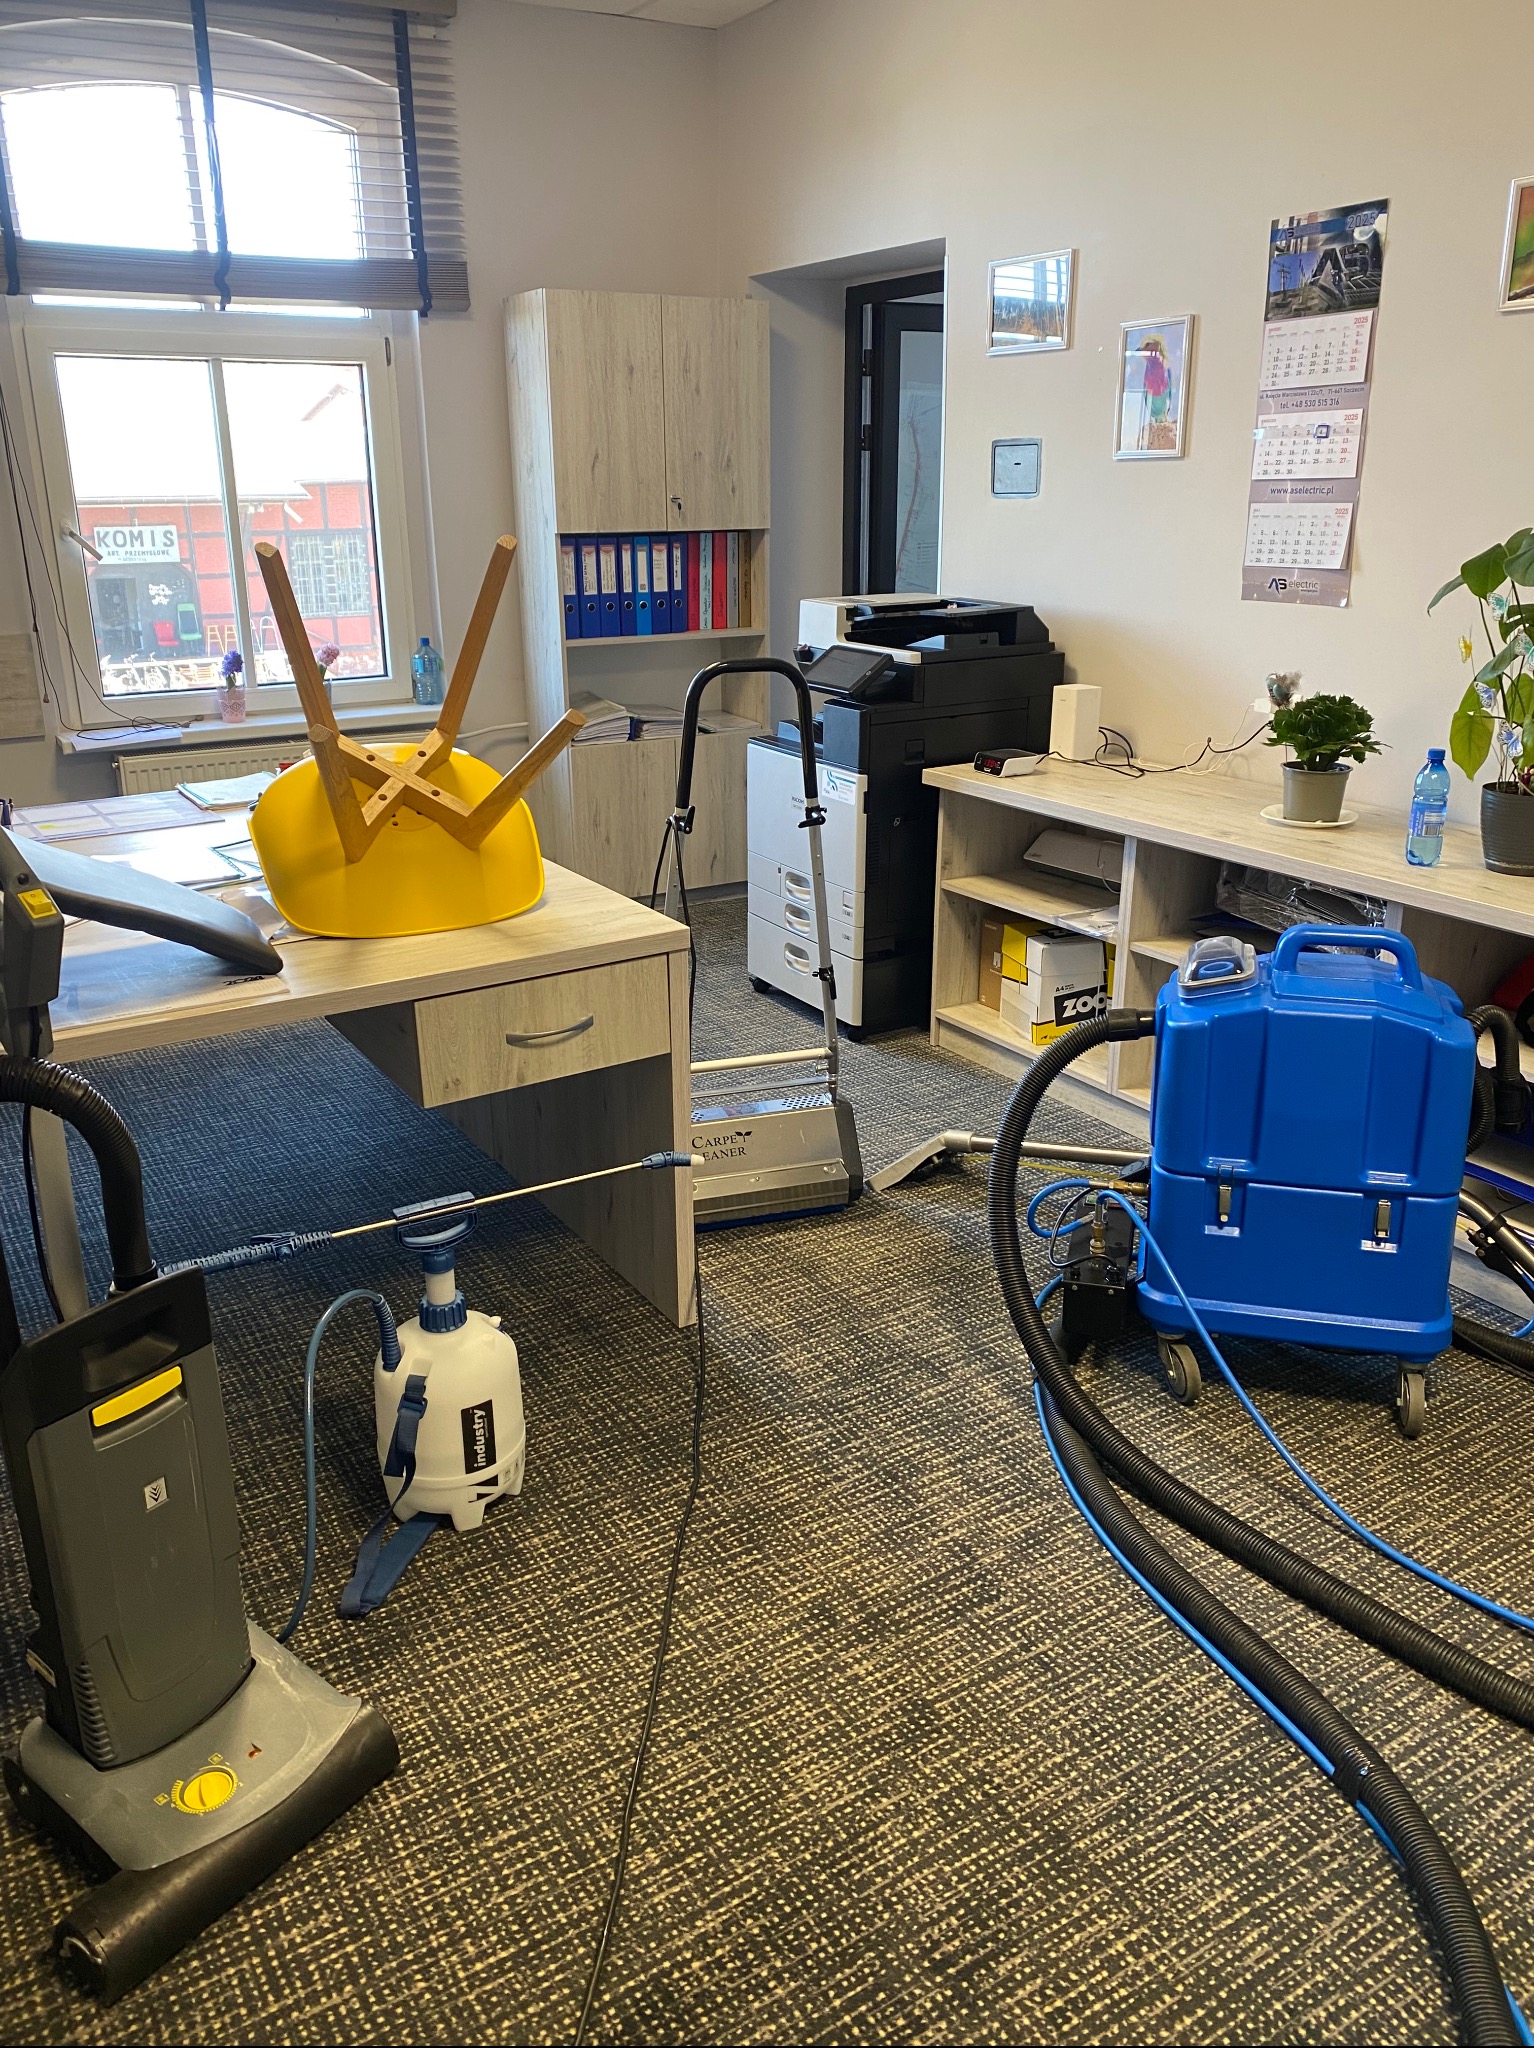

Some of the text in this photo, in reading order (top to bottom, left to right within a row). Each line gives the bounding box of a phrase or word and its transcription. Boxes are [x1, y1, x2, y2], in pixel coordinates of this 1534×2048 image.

[1347, 212, 1376, 230] 2025
[1354, 316, 1368, 325] 2025
[1270, 486, 1334, 495] www.aselectric.pl
[96, 530, 174, 547] KOMIS
[1289, 580, 1318, 589] electric
[702, 1146, 747, 1161] EANER
[473, 1409, 486, 1467] industry
